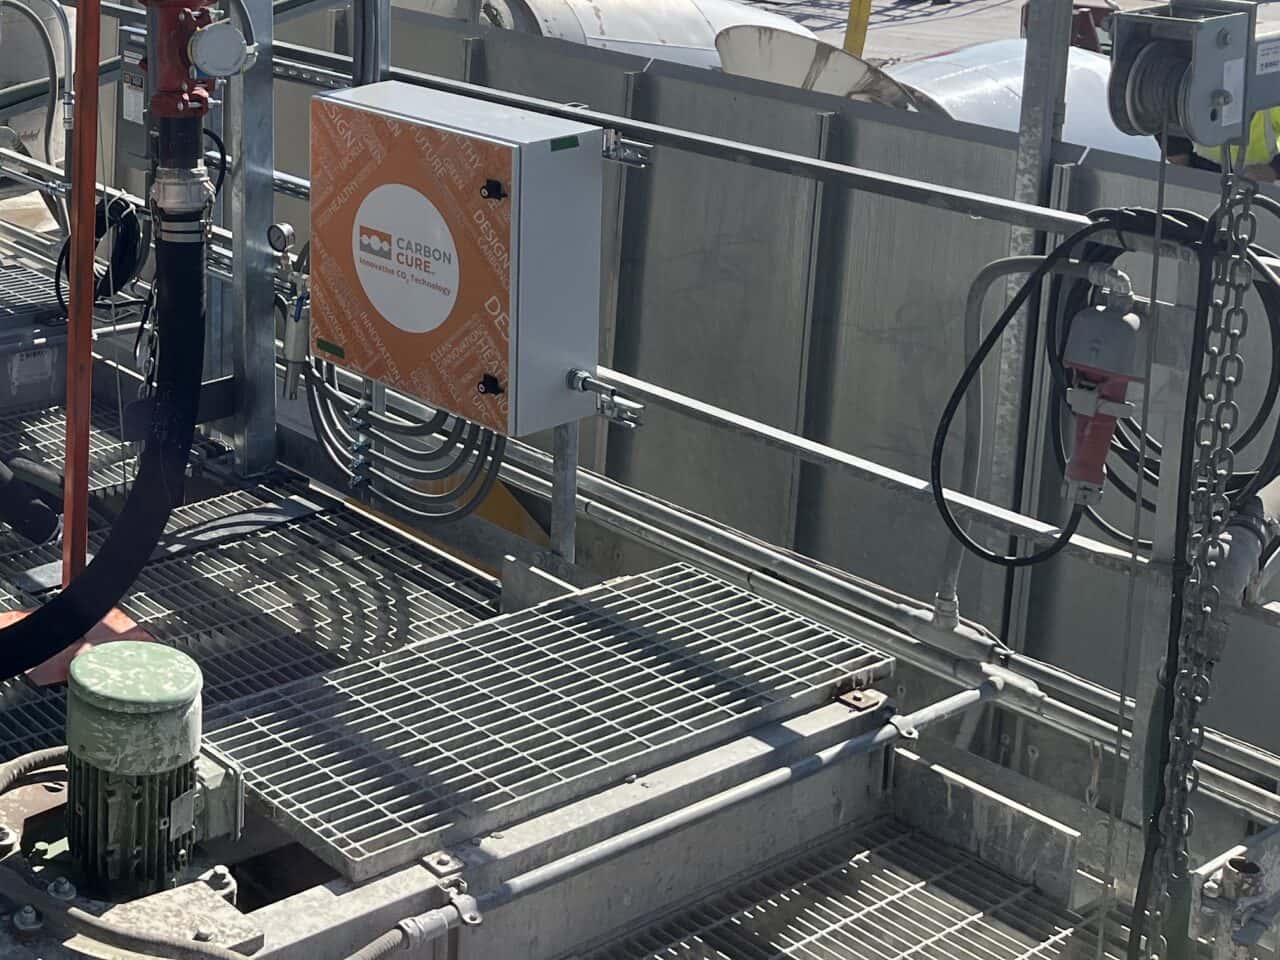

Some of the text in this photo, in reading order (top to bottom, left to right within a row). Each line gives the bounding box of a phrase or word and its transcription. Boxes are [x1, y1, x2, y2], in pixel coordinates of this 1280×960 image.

[396, 238, 452, 265] CARBON
[473, 209, 510, 269] DESIGN
[396, 252, 431, 273] CURE
